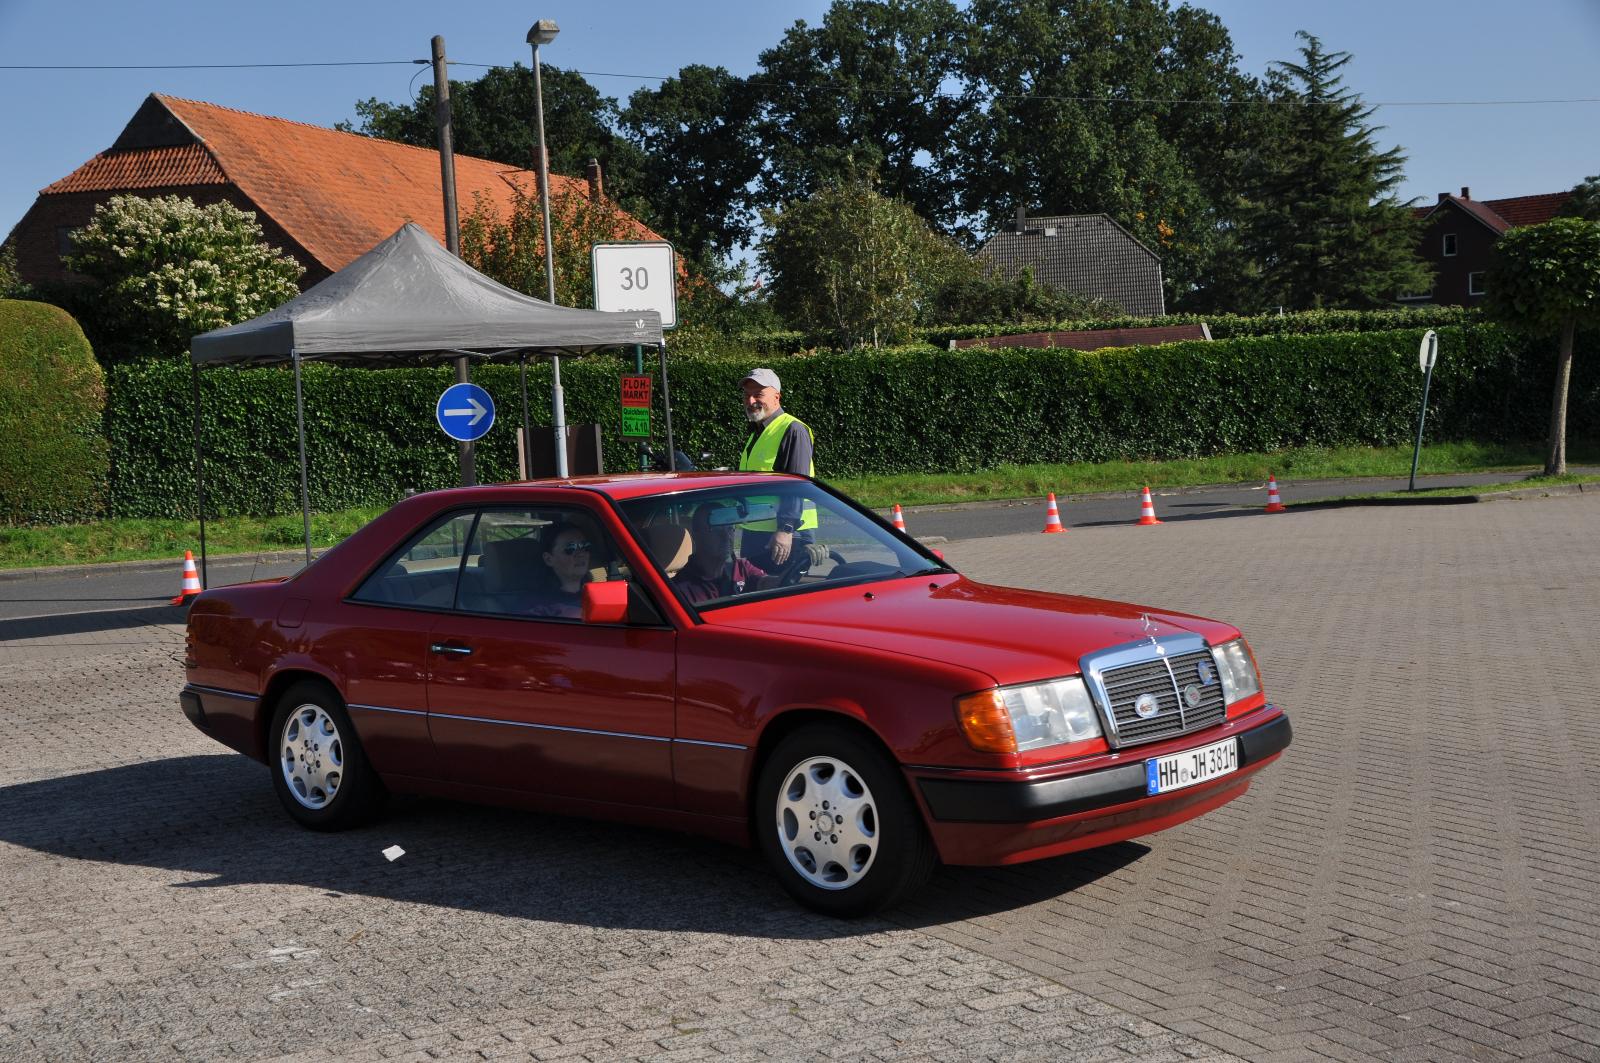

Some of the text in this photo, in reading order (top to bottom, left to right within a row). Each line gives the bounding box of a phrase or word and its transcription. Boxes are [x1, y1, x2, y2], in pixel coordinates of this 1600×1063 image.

[620, 266, 649, 290] 30
[623, 379, 649, 389] FLOH-
[623, 390, 649, 400] MARKT
[1159, 742, 1237, 788] HH JH 381H
[1151, 780, 1157, 788] D
